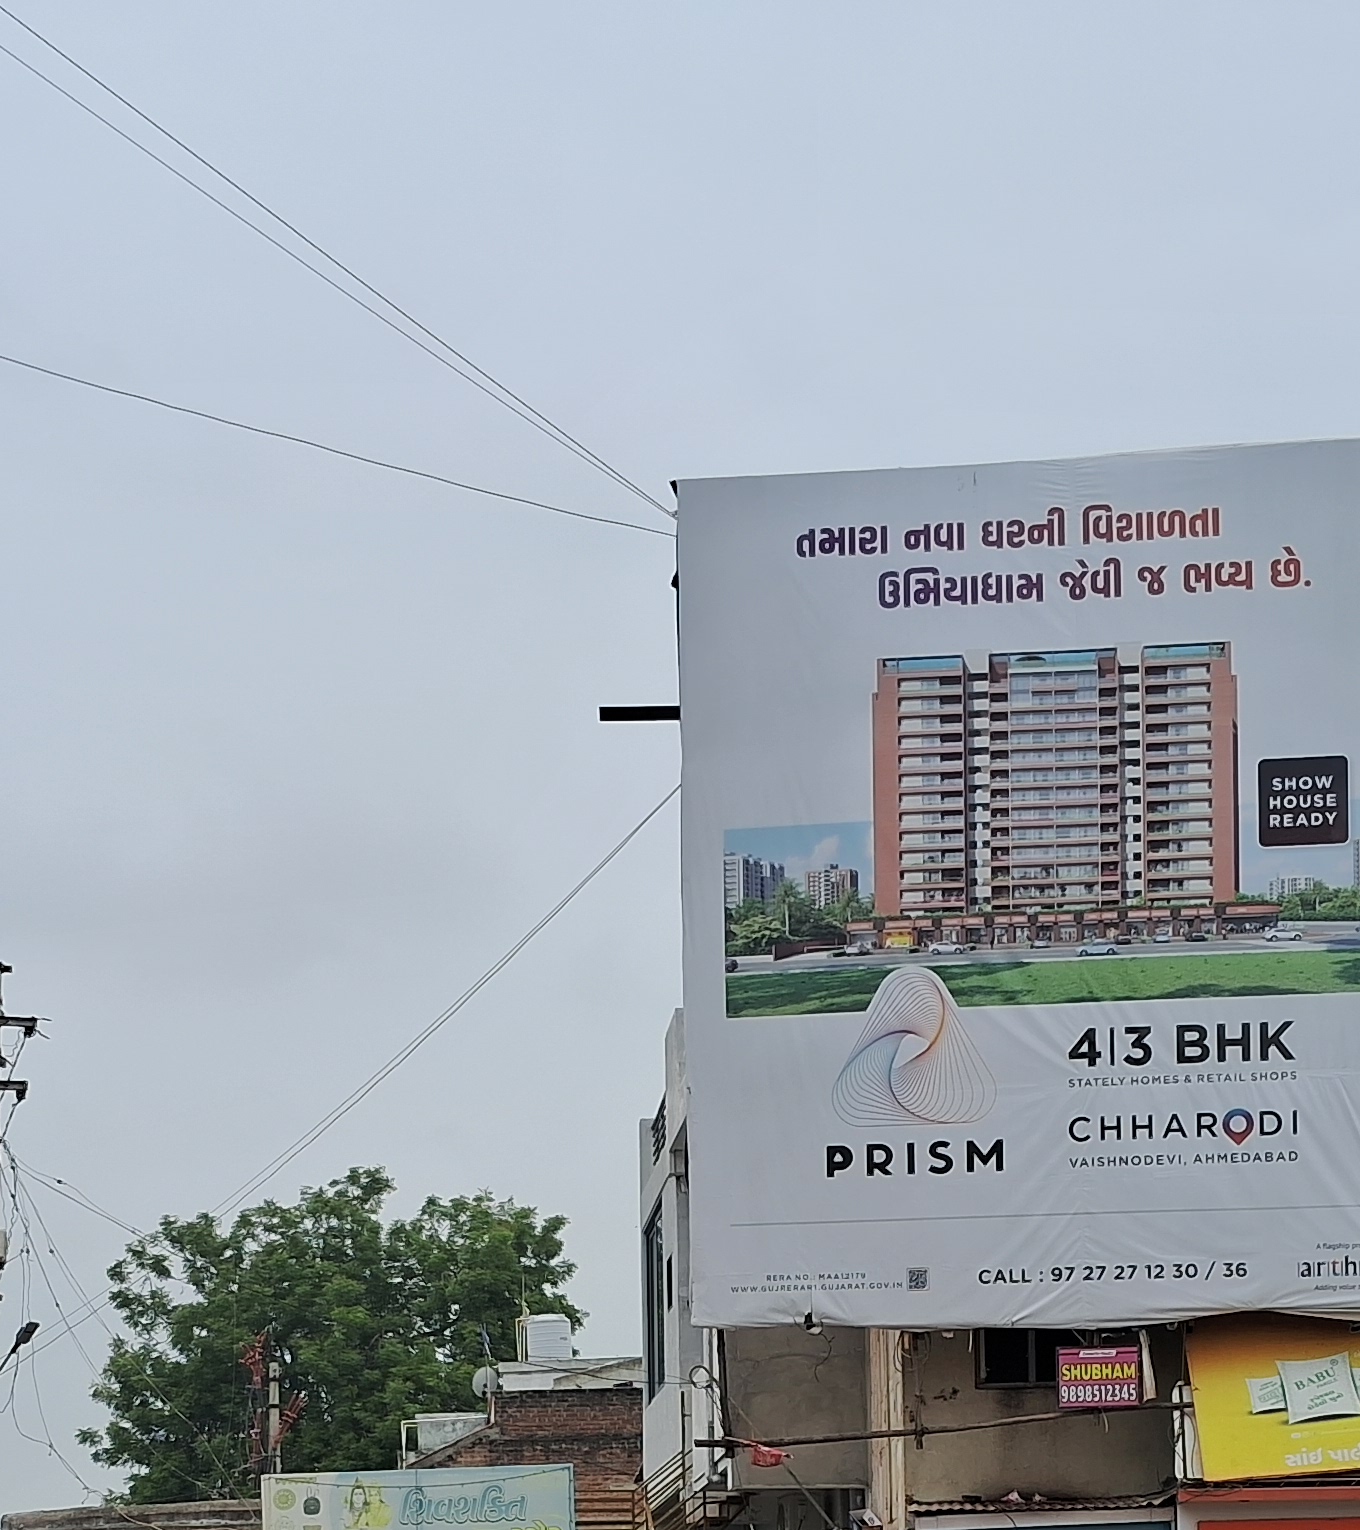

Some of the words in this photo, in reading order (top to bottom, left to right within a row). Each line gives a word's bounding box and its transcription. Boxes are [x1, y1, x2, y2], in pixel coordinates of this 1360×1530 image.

[796, 523, 888, 558] તમારા
[904, 521, 965, 551] નવા
[981, 507, 1065, 549] ઘરની
[1082, 504, 1220, 545] વિશાળતા
[878, 566, 1043, 609] ઉમિયાધામ
[1060, 556, 1122, 600] જેવી
[1137, 565, 1167, 596] જ
[1183, 559, 1254, 594] ભવ્ય
[1270, 546, 1312, 589] છે.
[1271, 775, 1333, 792] SHOW
[1269, 793, 1338, 811] HOUSE
[1268, 811, 1338, 829] READY
[1176, 1020, 1296, 1065] BHK
[1068, 1077, 1125, 1088] STATELY
[1131, 1075, 1179, 1086] HOMES
[1184, 1074, 1192, 1084] &
[1197, 1072, 1246, 1084] RETAIL
[1250, 1071, 1297, 1082] SHOPS
[1068, 1108, 1298, 1146] CHHARODI
[824, 1137, 1006, 1179] PRISM
[1069, 1154, 1187, 1169] VAISHNODEVI,
[1193, 1151, 1299, 1166] AHMEDABAD
[978, 1269, 1032, 1285] CALL
[1050, 1266, 1075, 1283] 97
[1081, 1265, 1106, 1282] 27
[1112, 1265, 1138, 1281] 27
[1144, 1264, 1167, 1280] 12
[1172, 1263, 1199, 1279] 30
[1221, 1262, 1248, 1279] 36
[1061, 1363, 1136, 1380] SHUBHAM
[1294, 1367, 1337, 1391] BABU
[1061, 1384, 1136, 1403] 9898512345
